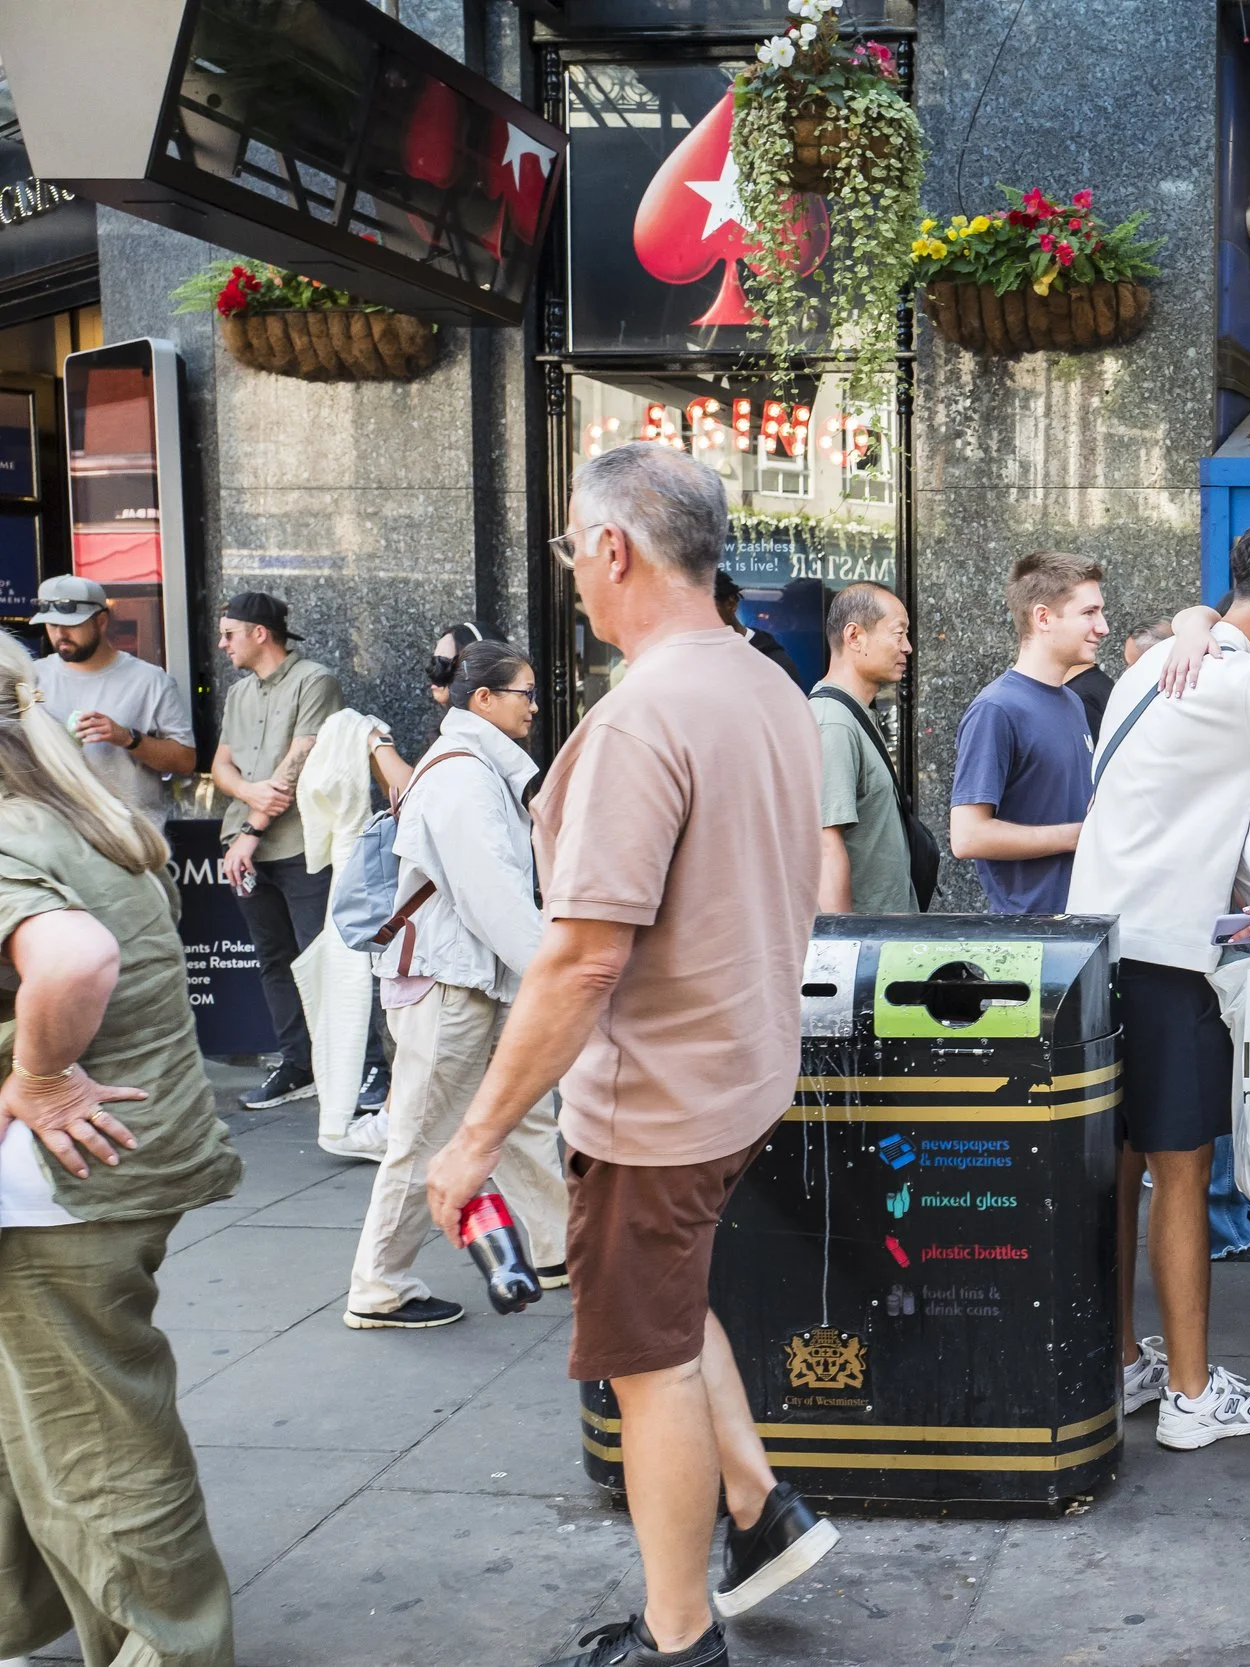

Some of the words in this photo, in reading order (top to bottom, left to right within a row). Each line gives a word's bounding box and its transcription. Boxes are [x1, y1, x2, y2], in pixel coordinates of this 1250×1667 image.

[740, 538, 795, 553] cashless
[717, 559, 731, 572] et
[736, 558, 745, 572] is
[750, 557, 779, 572] live!
[186, 959, 207, 969] ese
[190, 993, 215, 1005] OM
[921, 1139, 1010, 1154] newspapers
[920, 1153, 931, 1167] &
[934, 1155, 1013, 1170] magazines
[921, 1191, 971, 1207] mixed
[976, 1191, 1018, 1211] glass
[921, 1244, 972, 1262] plastic
[974, 1244, 1029, 1259] bottles
[922, 1284, 956, 1300] food
[960, 1286, 985, 1300] tins
[989, 1286, 1001, 1300] &
[925, 1300, 963, 1316] drink
[966, 1306, 1001, 1316] cans
[784, 1395, 803, 1407] City
[804, 1395, 814, 1406] of
[815, 1395, 869, 1406] Westminster
